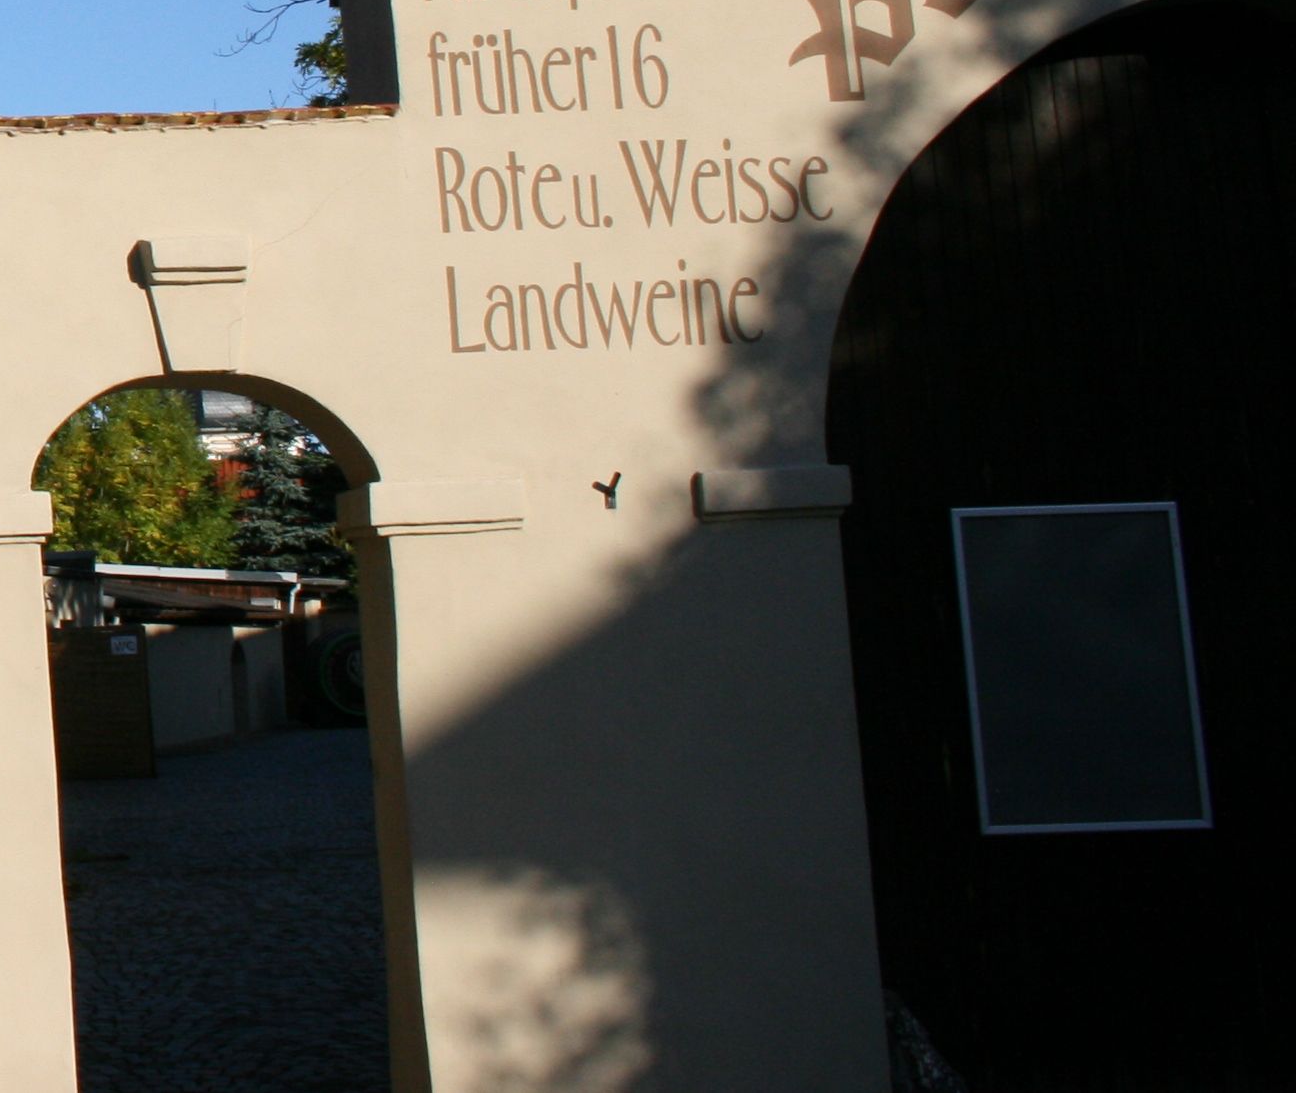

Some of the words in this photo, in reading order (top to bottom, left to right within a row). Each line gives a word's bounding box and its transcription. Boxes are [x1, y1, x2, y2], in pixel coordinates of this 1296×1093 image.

[427, 29, 598, 117] früher
[605, 23, 670, 110] 16
[619, 137, 835, 228] Weisse
[445, 259, 765, 353] Landweine
